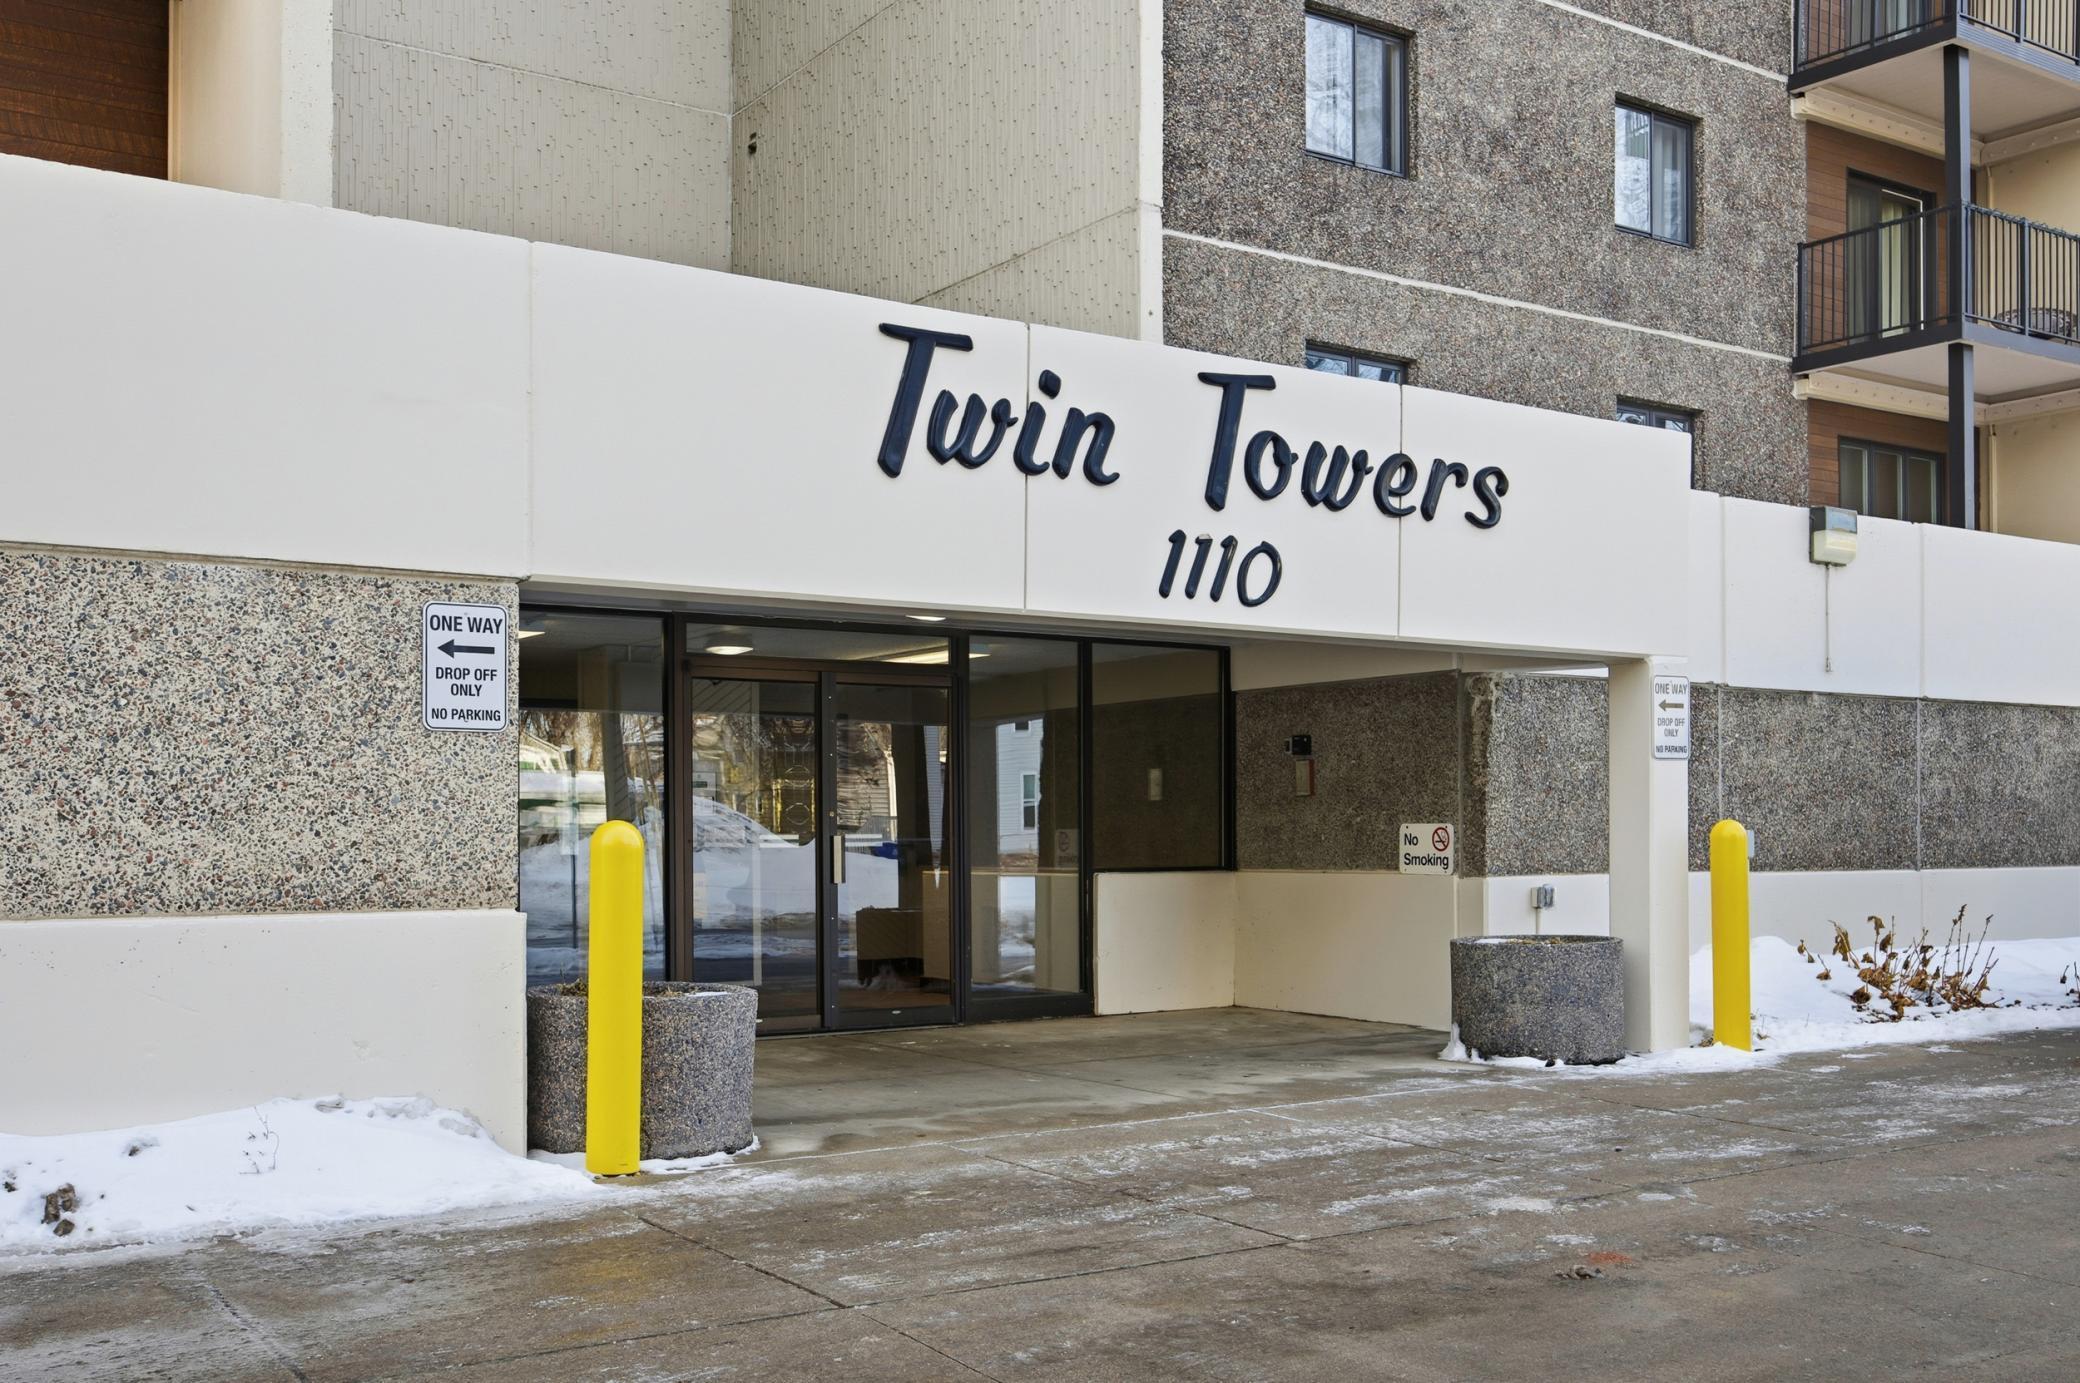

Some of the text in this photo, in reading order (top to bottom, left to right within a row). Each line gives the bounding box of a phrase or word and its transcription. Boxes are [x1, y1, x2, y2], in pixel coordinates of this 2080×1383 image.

[877, 321, 1510, 529] Twin Towers
[1158, 528, 1283, 608] 1110
[429, 615, 503, 634] ONE WAY
[435, 666, 498, 682] DROP OFF
[450, 683, 482, 697] ONLY
[1655, 683, 1687, 695] ONE WAY
[431, 707, 501, 722] NO PARKING
[1657, 718, 1685, 727] DROP OFF
[1664, 728, 1678, 737] ONLY
[1404, 833, 1418, 846] No
[1404, 853, 1449, 870] Smoking
